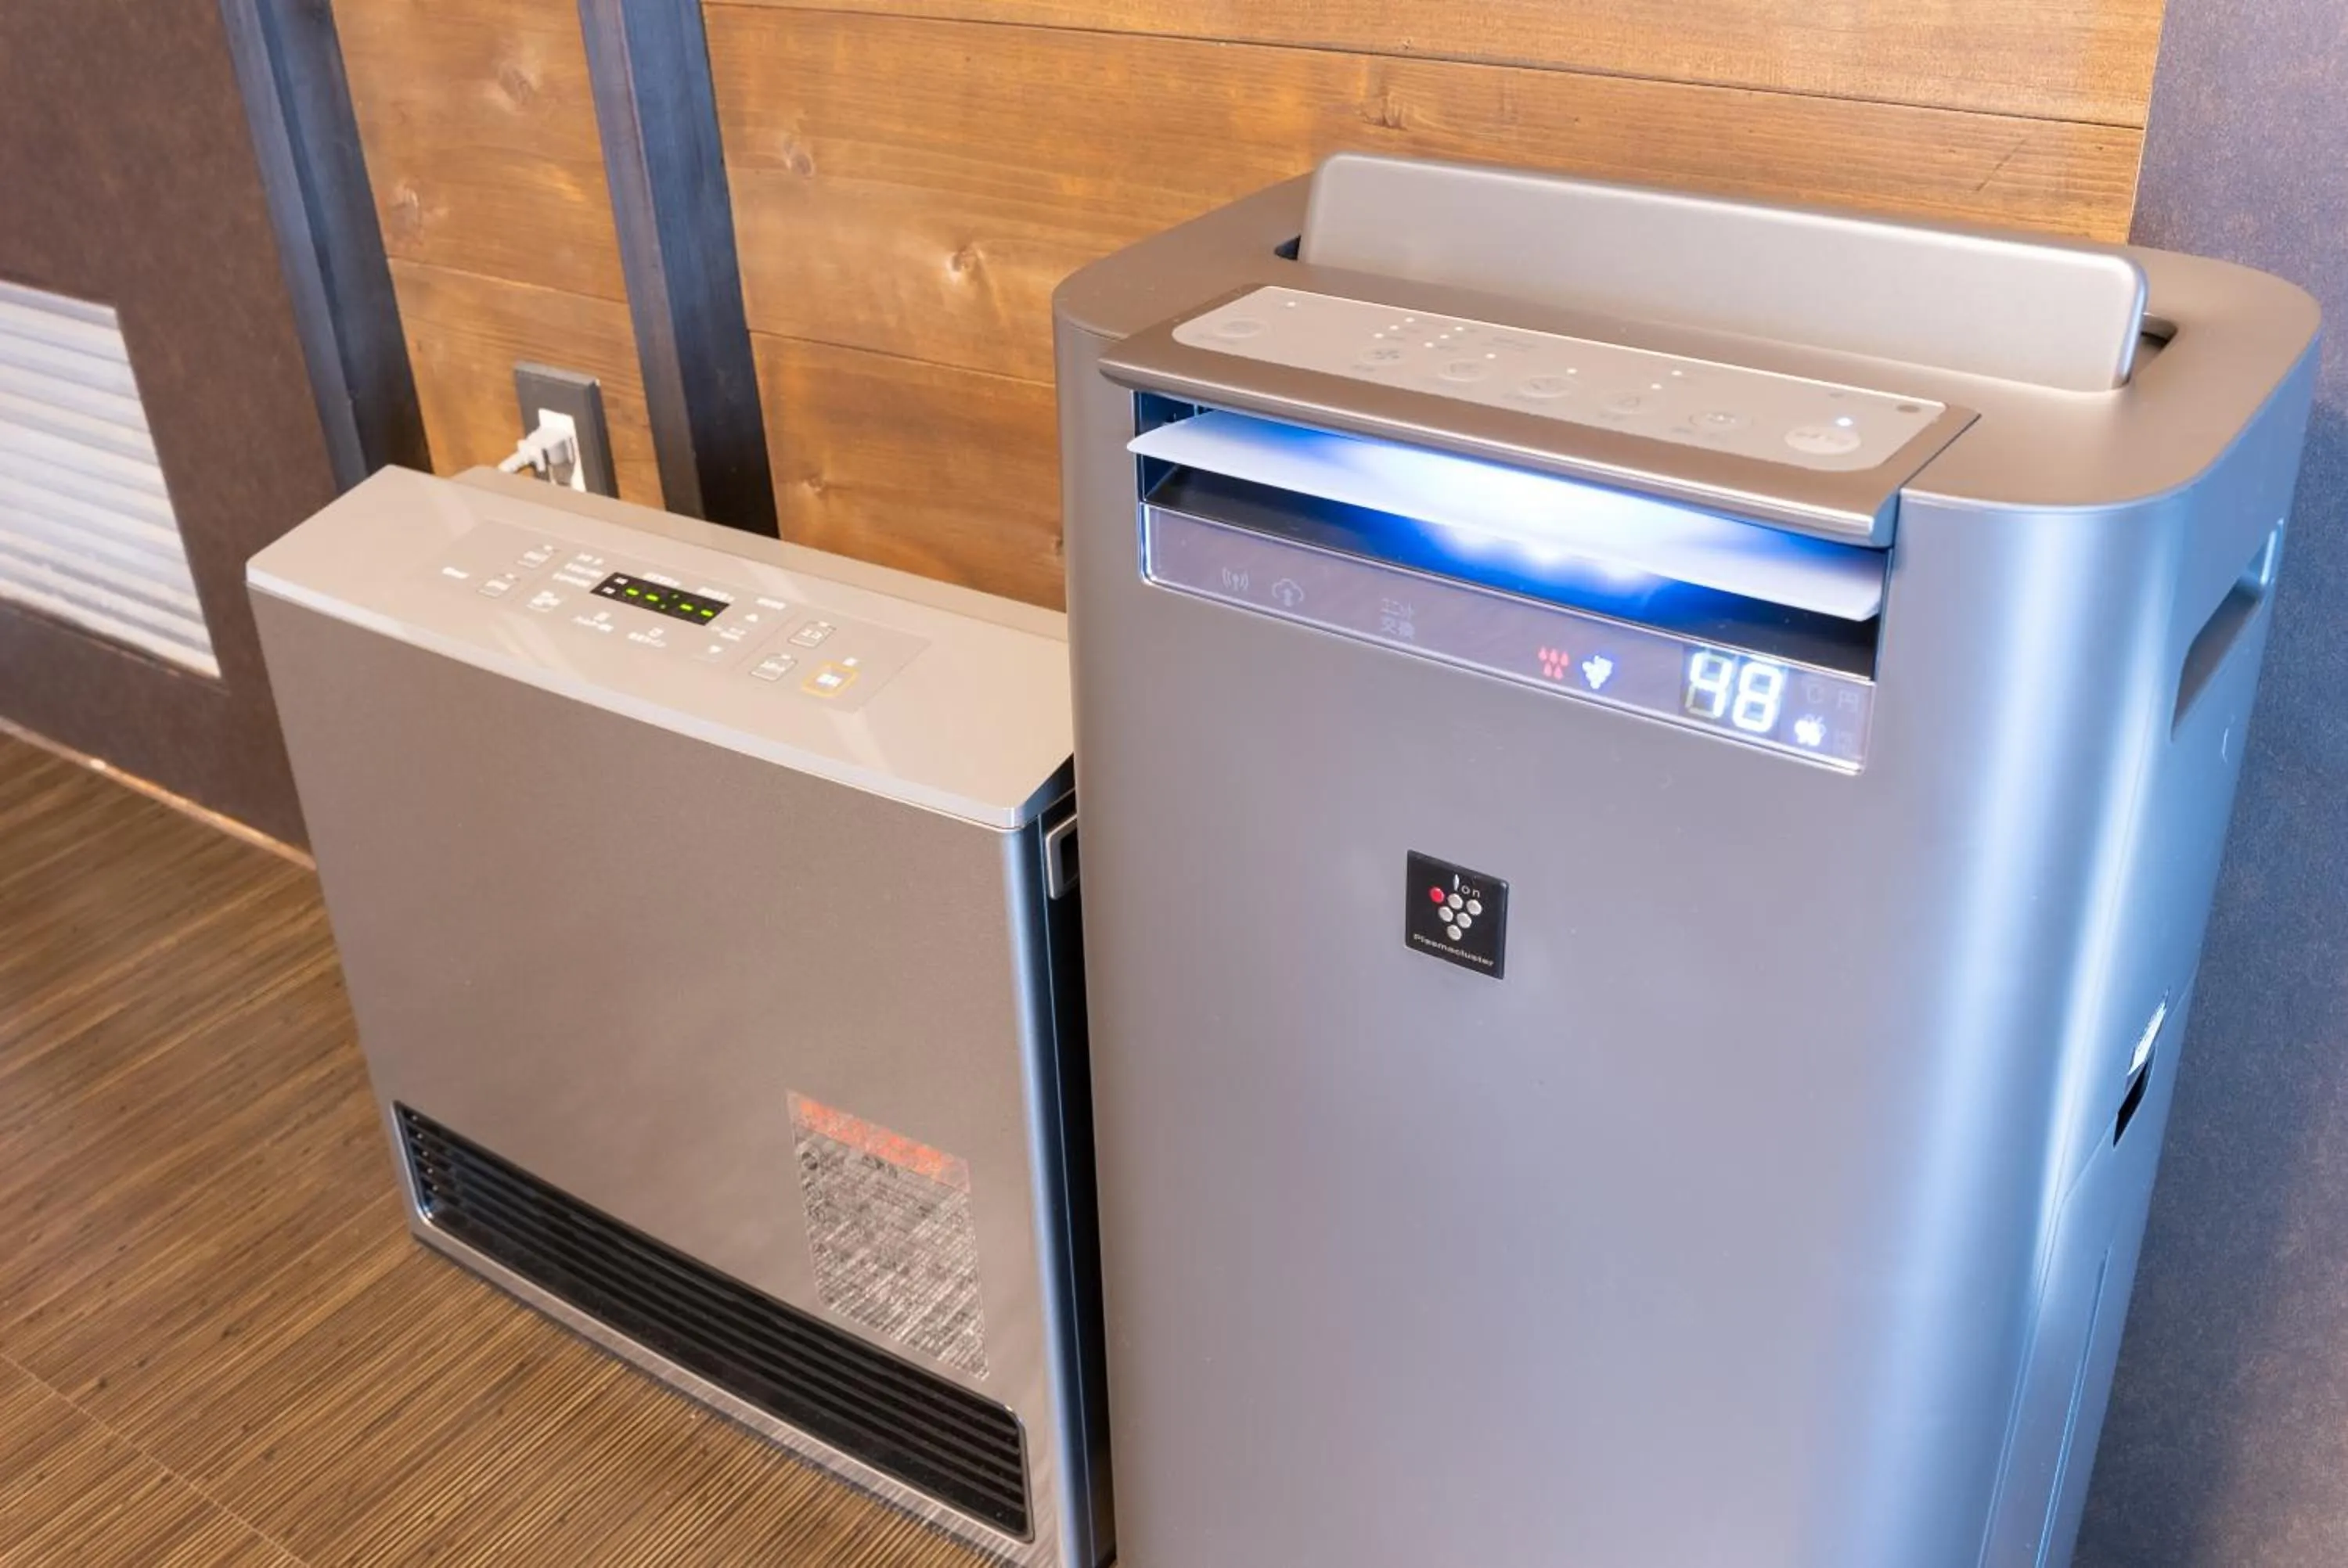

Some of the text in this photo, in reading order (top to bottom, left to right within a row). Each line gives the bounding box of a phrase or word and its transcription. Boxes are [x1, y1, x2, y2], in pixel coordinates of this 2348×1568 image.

[1688, 651, 1783, 733] 48
[1453, 874, 1481, 899] Ion
[1413, 933, 1494, 967] Plasmacluster
